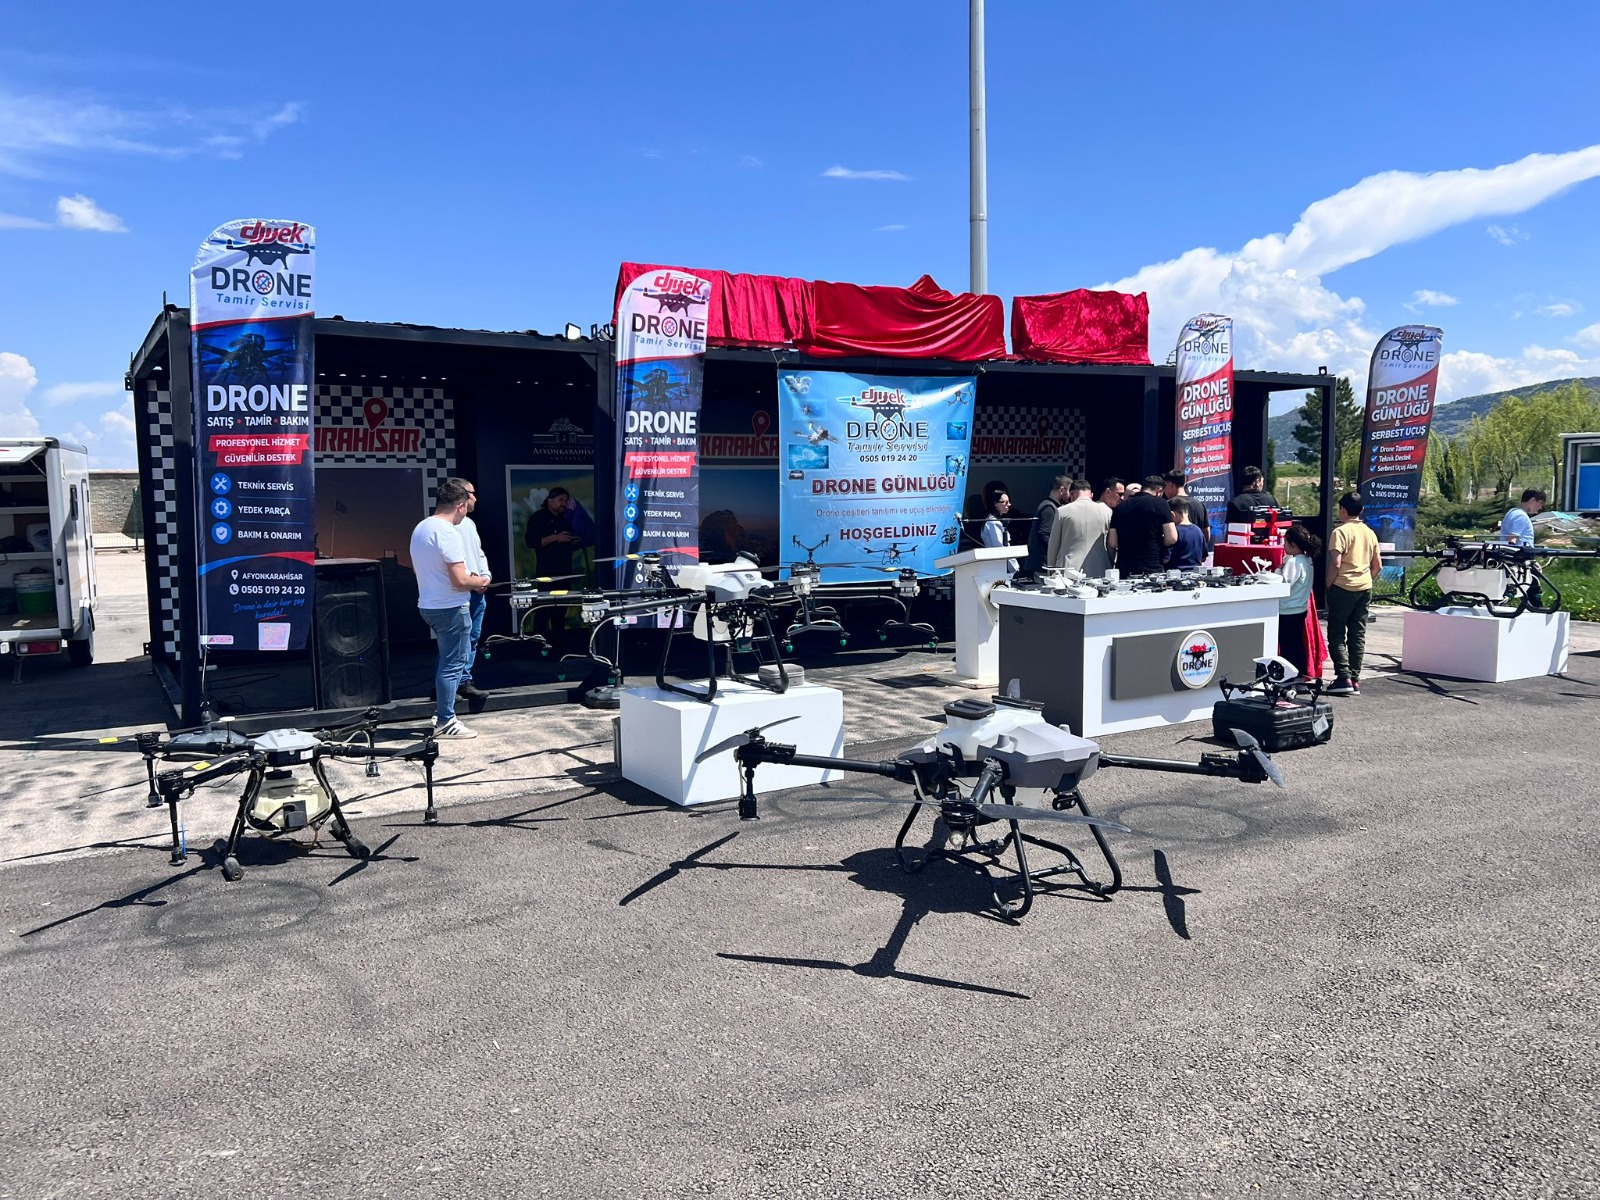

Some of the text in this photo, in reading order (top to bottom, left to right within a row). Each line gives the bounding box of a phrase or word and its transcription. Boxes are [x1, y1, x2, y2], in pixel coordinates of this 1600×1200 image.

[211, 266, 312, 298] DRONE
[216, 293, 309, 310] Tamir Servisi
[631, 313, 705, 341] DRONE
[634, 335, 702, 351] Tamir Servisi
[1184, 340, 1229, 355] DRONE
[1380, 349, 1435, 362] DRONE
[1183, 377, 1229, 403] DRONE
[1375, 383, 1429, 407] DRONE
[207, 384, 308, 412] DRONE
[1181, 396, 1232, 421] GÜNLÜĞÜ
[1371, 400, 1430, 422] GÜNLÜĞÜ
[207, 413, 309, 430] SATIŞ TAMİR BAKIM
[625, 410, 697, 434] DRONE
[1395, 419, 1401, 427] &
[846, 420, 928, 441] DRONE
[1182, 421, 1232, 440] SERBEST UÇUŞ
[1371, 425, 1427, 441] SERBEST UÇUŞ
[216, 436, 301, 448] PROFESYONEL HİZMET
[624, 435, 696, 447] SATIŞ TAMİR BAKIM
[848, 441, 928, 452] Tamir Servisi
[224, 453, 296, 463] GÜVENİLİR DESTEK
[629, 454, 690, 463] PROFESYONEL HİZMET
[1192, 453, 1224, 464] Teknik Destek
[1379, 454, 1412, 463] Teknik Destek
[634, 466, 687, 475] GÜVENİLİR DESTEK
[1192, 466, 1208, 474] Serbest
[238, 479, 294, 492] TEKNİK SERVİS
[812, 473, 956, 494] DRONE GÜNLÜĞÜ
[644, 489, 685, 499] TEKNİK SERVİS
[238, 505, 290, 518] YEDEK PARÇA
[663, 511, 682, 519] PARÇA
[816, 508, 840, 517] Drone
[238, 530, 302, 540] BAKIM & ONARIM
[661, 530, 666, 538] &
[667, 530, 690, 538] ONARIM
[840, 522, 937, 542] HOŞGELDİNİZ
[242, 572, 303, 580] AFYONKARAHİSAR
[241, 585, 306, 595] 0505 019 24 20
[1182, 658, 1213, 671] DRONE
